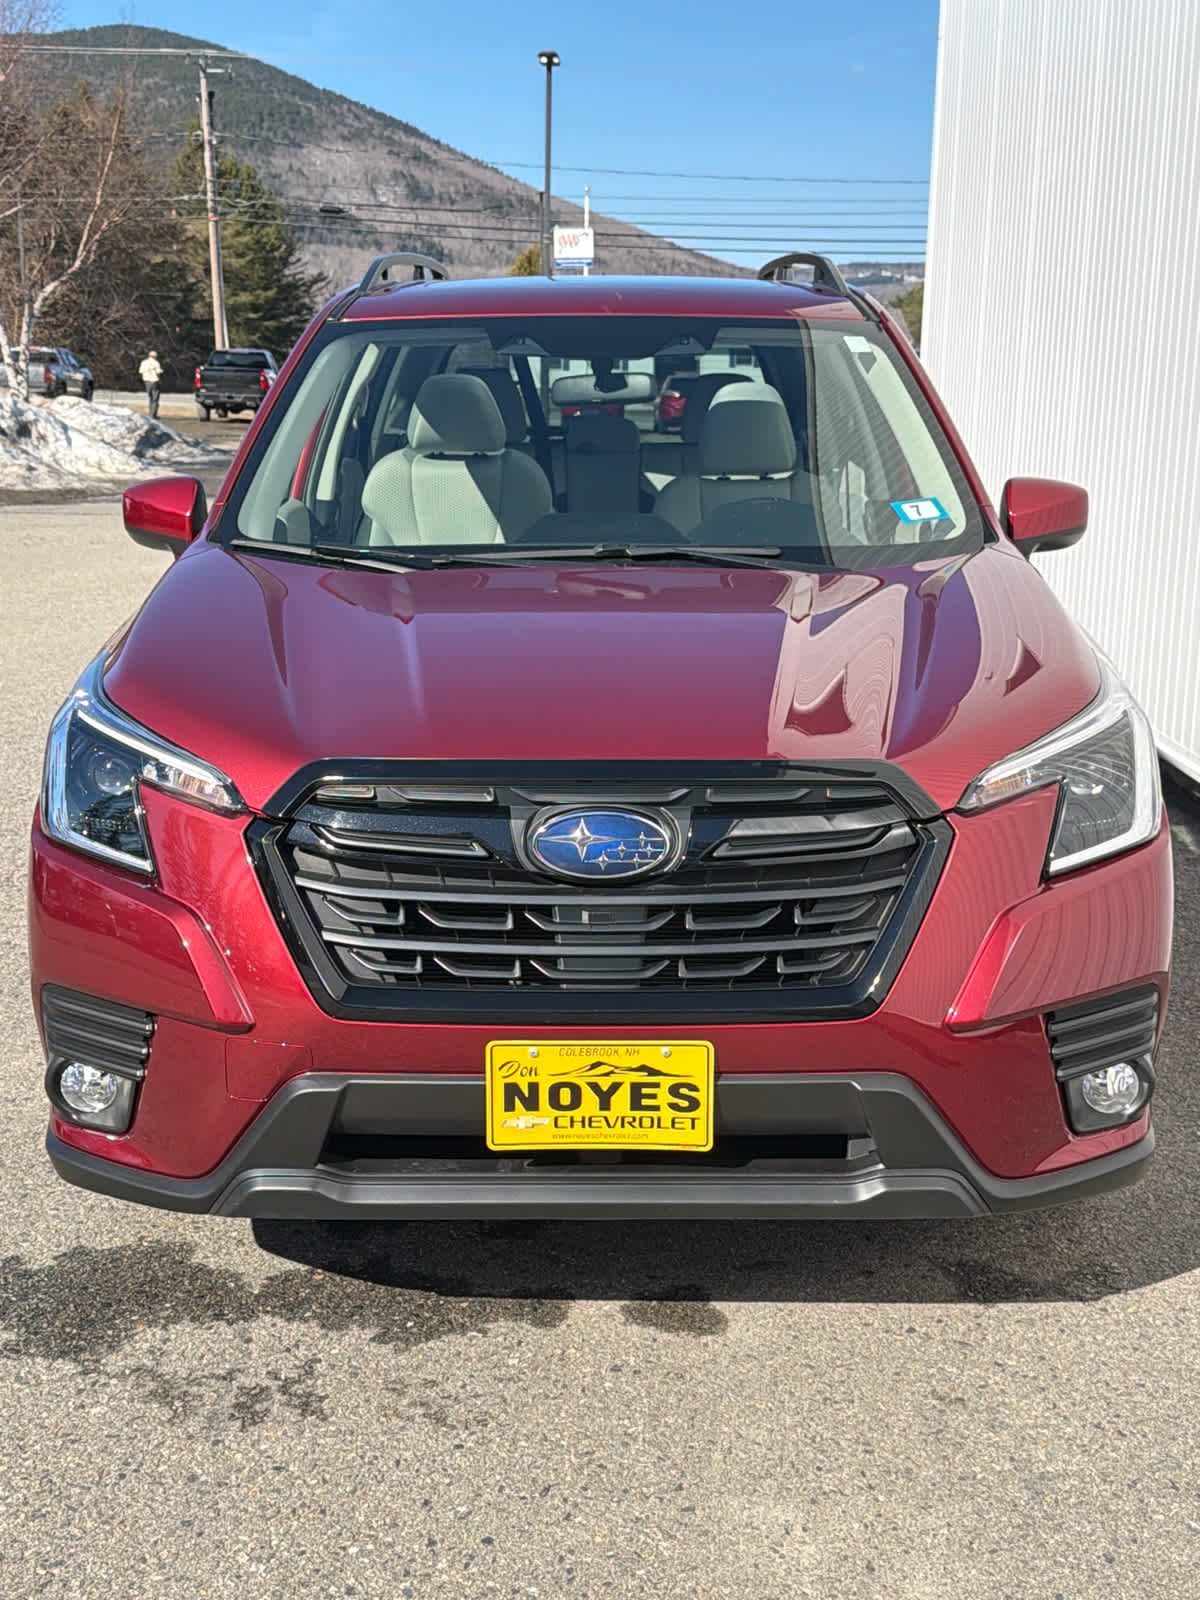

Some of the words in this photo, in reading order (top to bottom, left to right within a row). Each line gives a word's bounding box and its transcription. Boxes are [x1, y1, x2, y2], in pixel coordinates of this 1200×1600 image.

[909, 504, 922, 516] 7
[625, 1047, 641, 1057] NH
[498, 1060, 538, 1079] Don
[503, 1081, 701, 1113] NOYES
[553, 1115, 701, 1131] CHEVROLET
